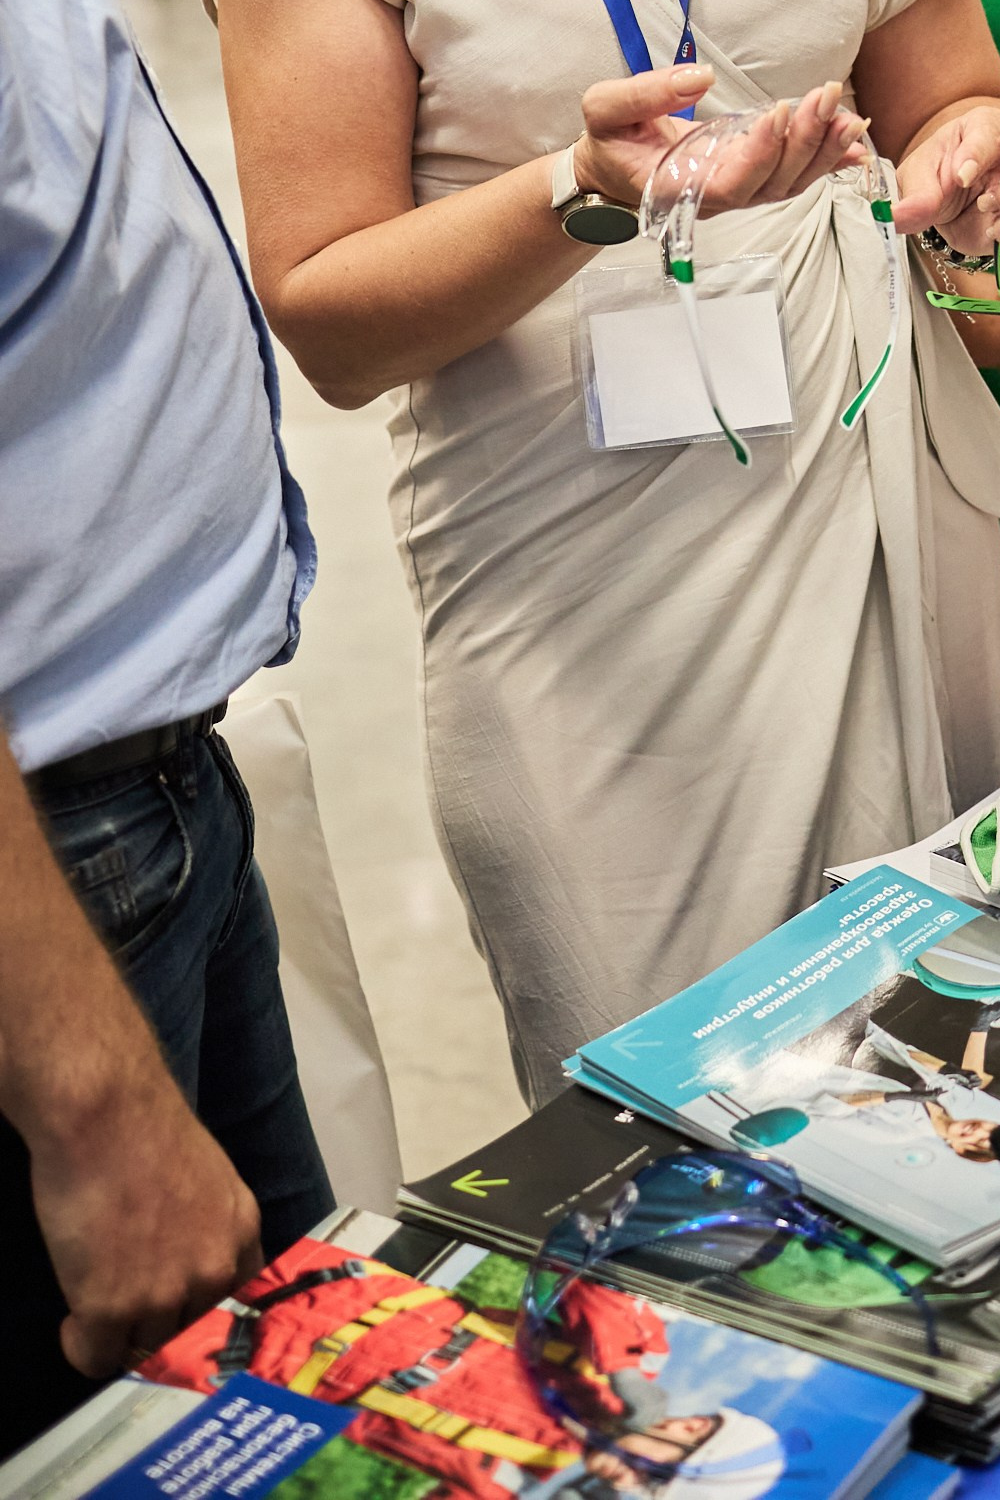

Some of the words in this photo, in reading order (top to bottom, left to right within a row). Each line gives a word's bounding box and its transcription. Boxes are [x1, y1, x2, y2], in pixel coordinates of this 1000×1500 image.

[787, 888, 917, 981] здравоохранения
[870, 897, 934, 940] Одежда
[840, 935, 872, 962] для
[691, 983, 777, 1041] индустрии
[752, 953, 844, 1022] работников
